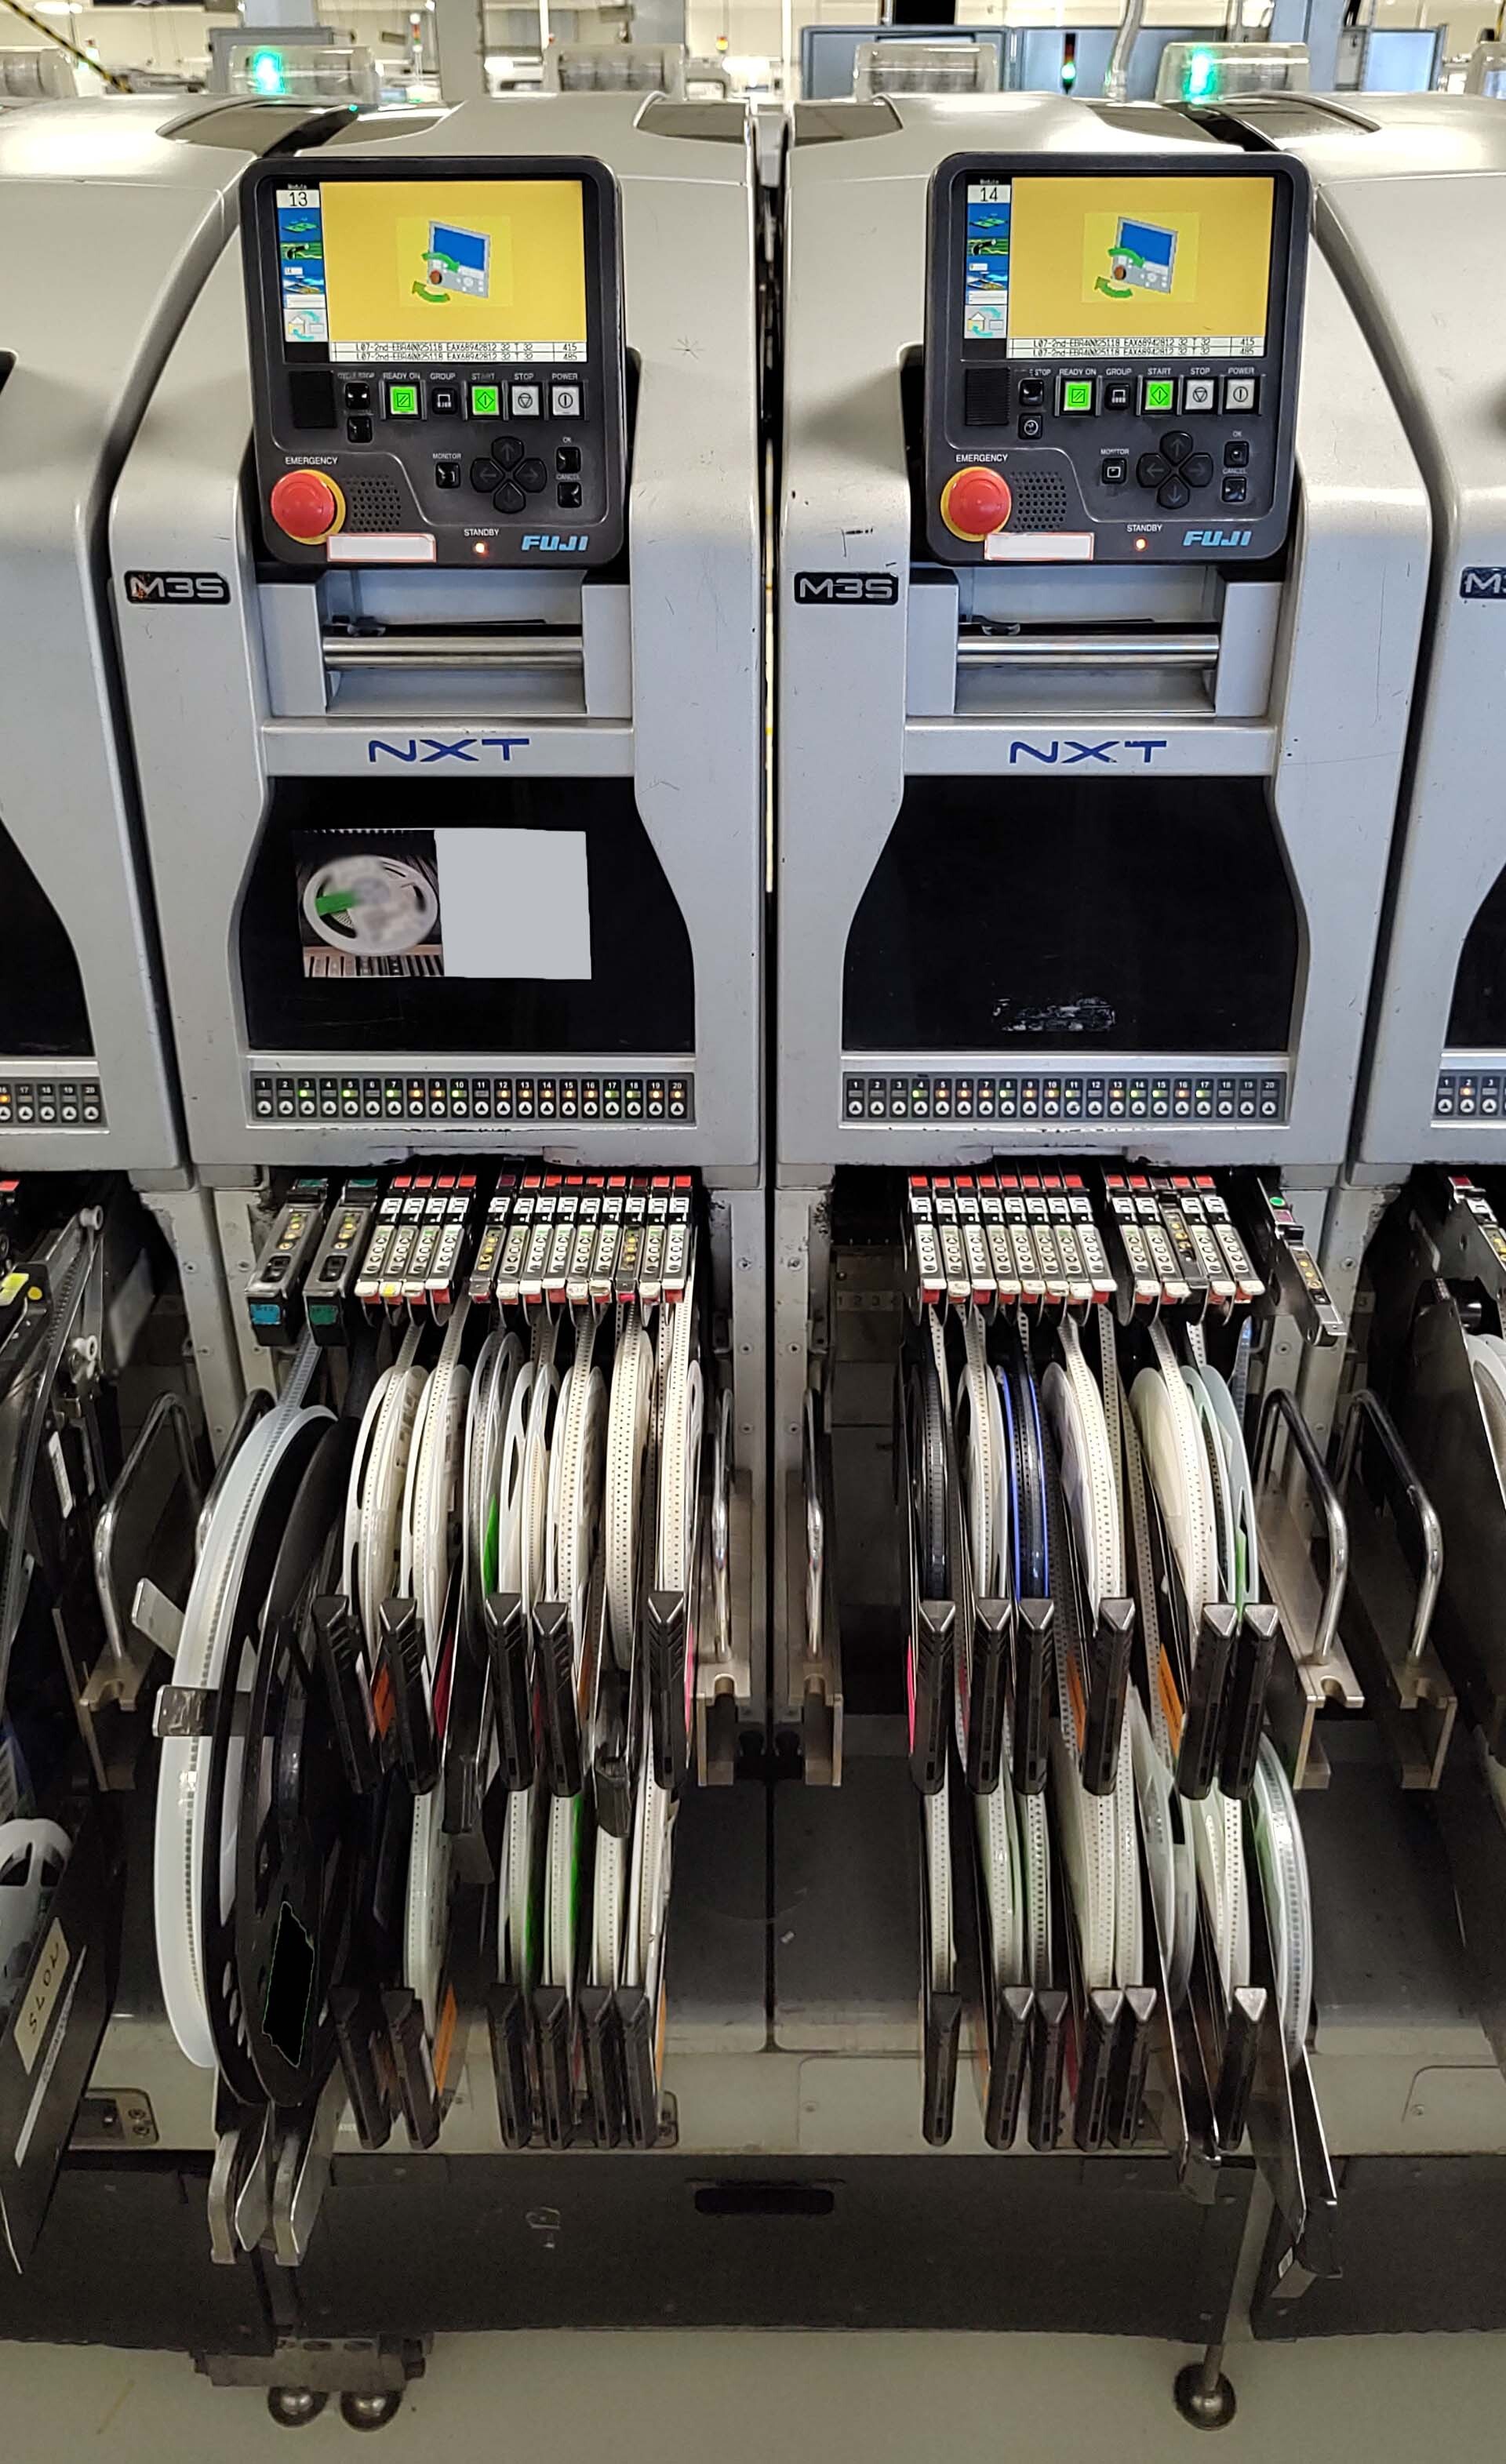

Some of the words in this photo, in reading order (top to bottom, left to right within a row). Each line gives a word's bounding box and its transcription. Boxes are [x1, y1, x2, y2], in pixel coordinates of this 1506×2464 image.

[289, 191, 307, 207] 13
[980, 187, 998, 202] 14
[430, 372, 456, 380] GROUP
[1148, 367, 1171, 376] START
[1228, 366, 1255, 375] POWER
[285, 456, 338, 465] EMERGENCY
[955, 454, 1008, 463] EMERGENCY
[464, 529, 500, 537] STANDBY
[1126, 524, 1162, 532] STANDBY
[521, 535, 589, 551] FUJI
[1183, 530, 1253, 547] FUJI
[130, 576, 224, 598] M3S
[799, 578, 893, 598] M3S
[368, 738, 530, 762] NXT
[1009, 740, 1168, 763] NXT
